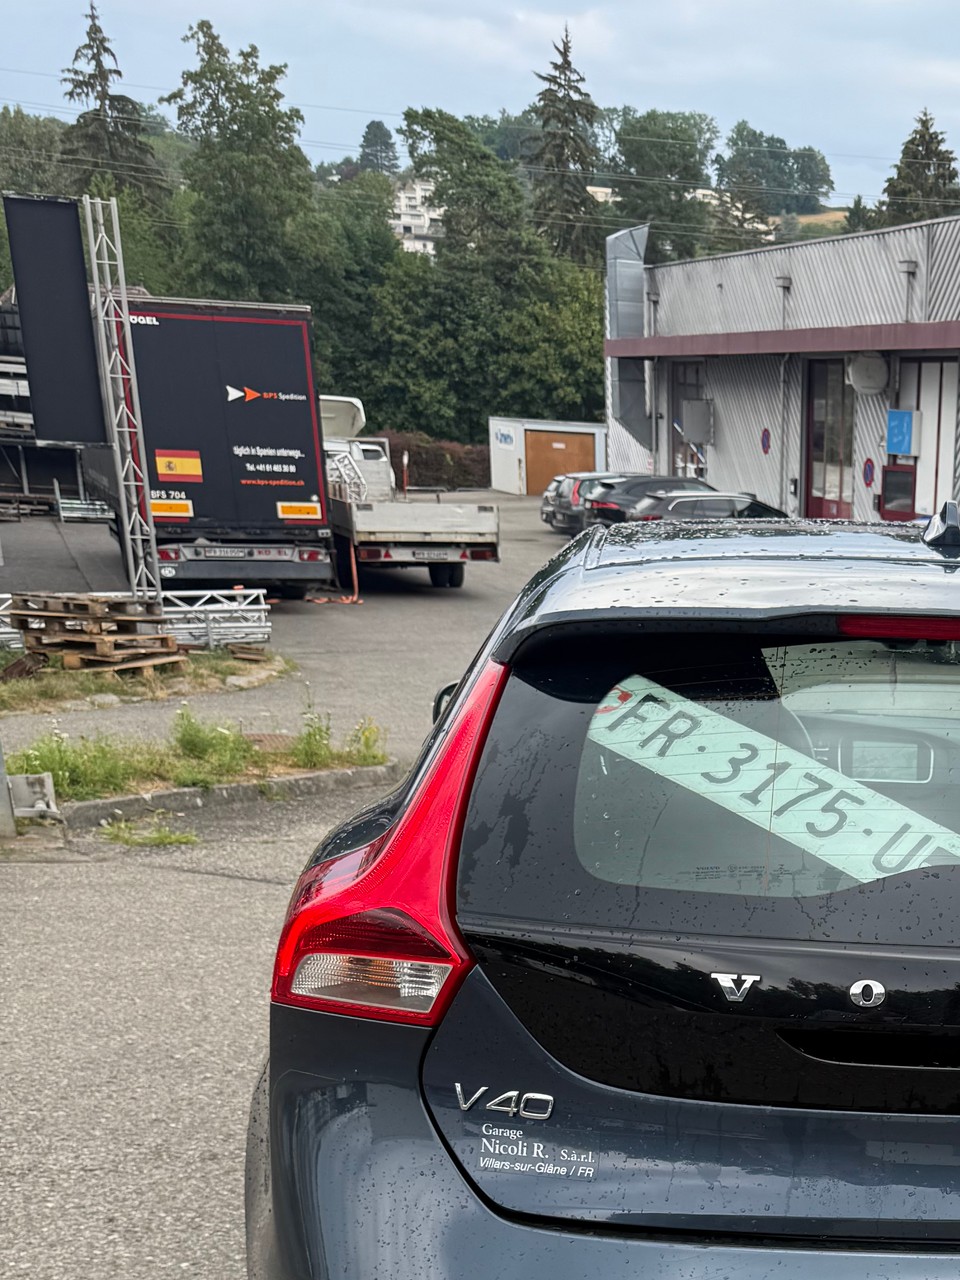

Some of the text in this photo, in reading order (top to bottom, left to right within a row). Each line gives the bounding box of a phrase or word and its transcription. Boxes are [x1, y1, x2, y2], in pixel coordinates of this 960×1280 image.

[278, 391, 307, 402] Spedition
[168, 490, 187, 500] 704
[454, 1082, 554, 1120] V40
[481, 1123, 524, 1140] Garage
[481, 1137, 596, 1164] Nicoli R. S.à.r.l.
[479, 1156, 568, 1176] Villars-sur-Glâne
[577, 1166, 595, 1178] FR
